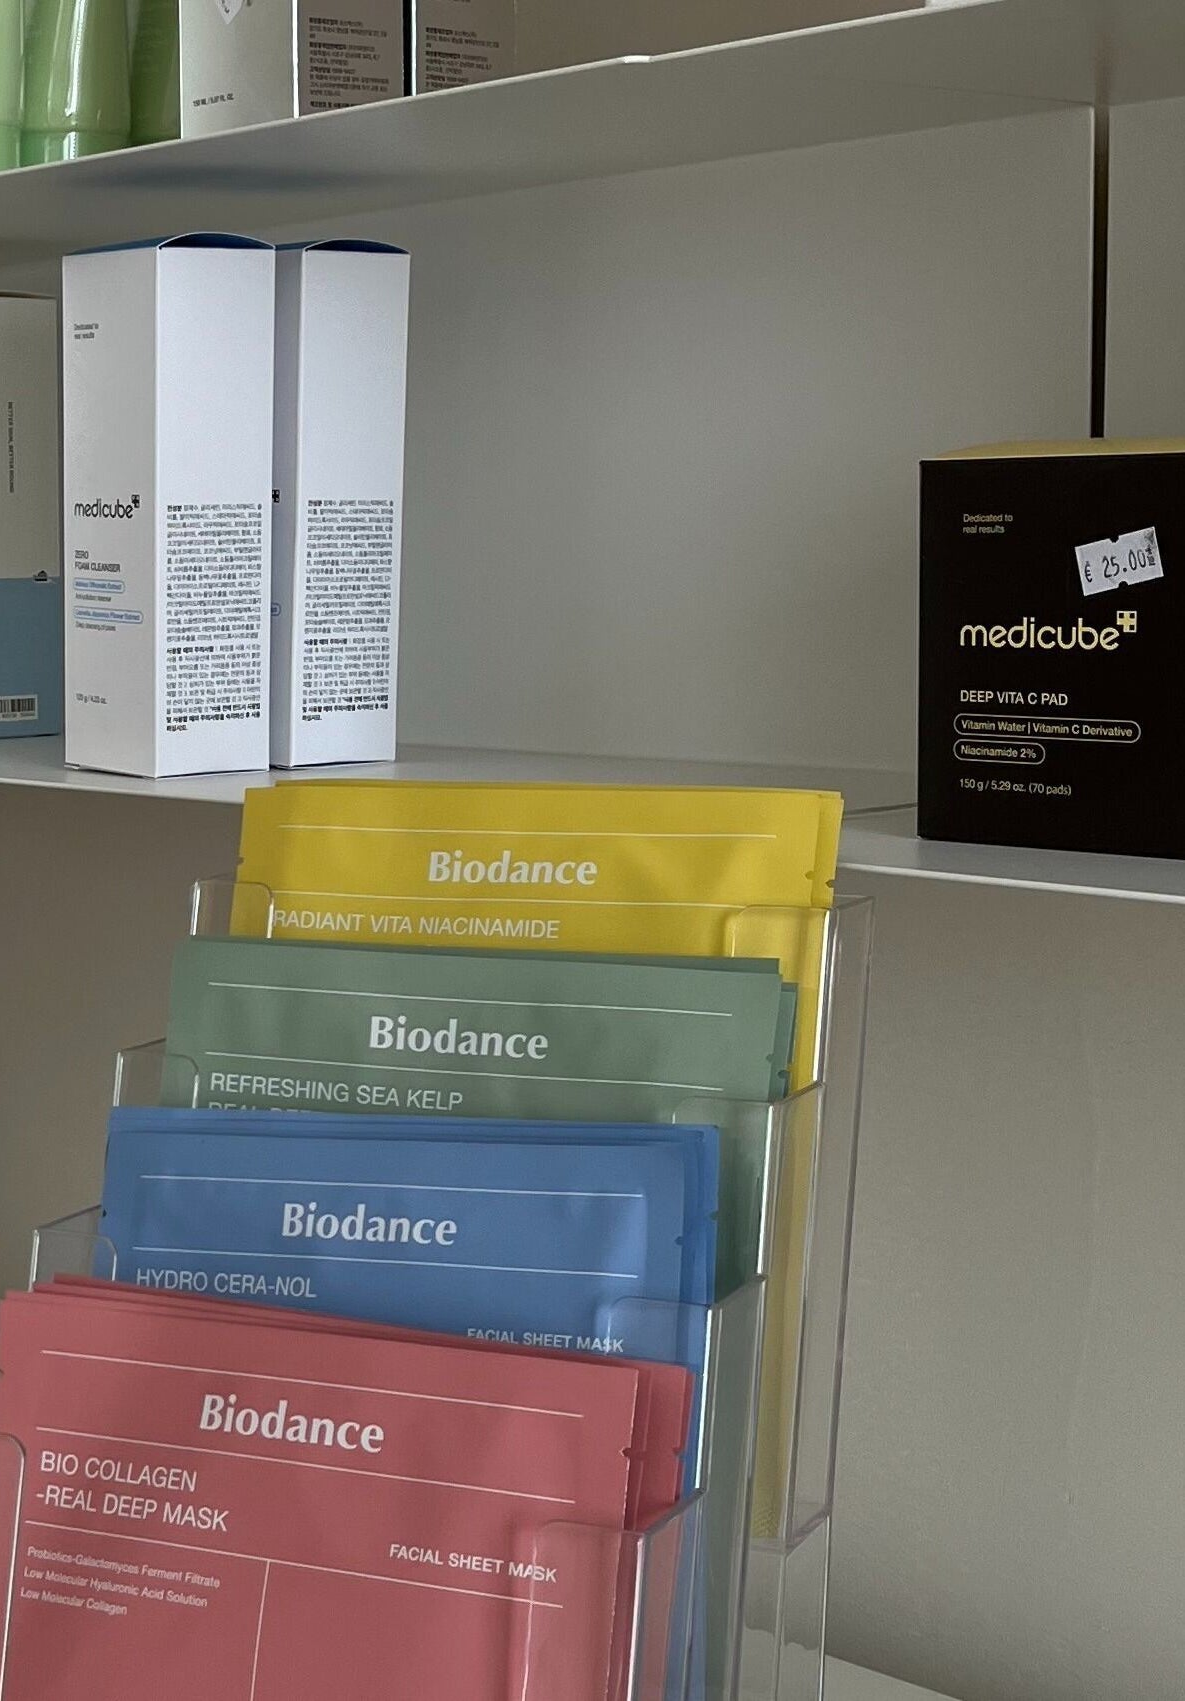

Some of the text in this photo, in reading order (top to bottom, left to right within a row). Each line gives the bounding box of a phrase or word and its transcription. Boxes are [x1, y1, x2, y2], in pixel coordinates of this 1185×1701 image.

[74, 498, 134, 519] medicube
[963, 513, 1013, 523] Dedicated to
[963, 525, 1005, 534] real results
[960, 616, 1120, 650] medicube
[960, 690, 1069, 706] DEEP VITA C PAD
[961, 719, 996, 732] Vitamin
[998, 721, 1026, 732] Water
[1032, 722, 1070, 735] Vitamin
[1071, 724, 1080, 734] C
[1082, 725, 1133, 737] Derivative
[961, 745, 1036, 759] Niacinamide 2%
[959, 778, 975, 790] 150
[976, 781, 984, 792] g
[991, 780, 1011, 791] 5.29
[1012, 783, 1026, 792] oz.
[1029, 783, 1045, 795] (70
[1046, 784, 1072, 797] pads)
[427, 850, 598, 886] Biodance
[273, 910, 561, 939] RADIANT VITA NIACINAMIDE
[368, 1015, 550, 1060] Biodance
[210, 1072, 464, 1112] REFRESHING SEA KELP
[280, 1200, 459, 1247] Biodance
[136, 1268, 317, 1298] HYDRO CERA-NOL
[467, 1328, 624, 1353] FACIAL SHEET MASK
[198, 1393, 386, 1454] Biodance
[40, 1450, 198, 1492] BIO COLLAGEN
[36, 1484, 230, 1532] -REAL DEEP MASK
[141, 1564, 183, 1582] Ferment
[184, 1572, 221, 1589] Filtrate
[389, 1543, 558, 1583] FACIAL SHEET MASK
[23, 1566, 208, 1607] Low Molecular Hyaluronic Acid Solution
[20, 1587, 128, 1616] Low Molecular Collagen
